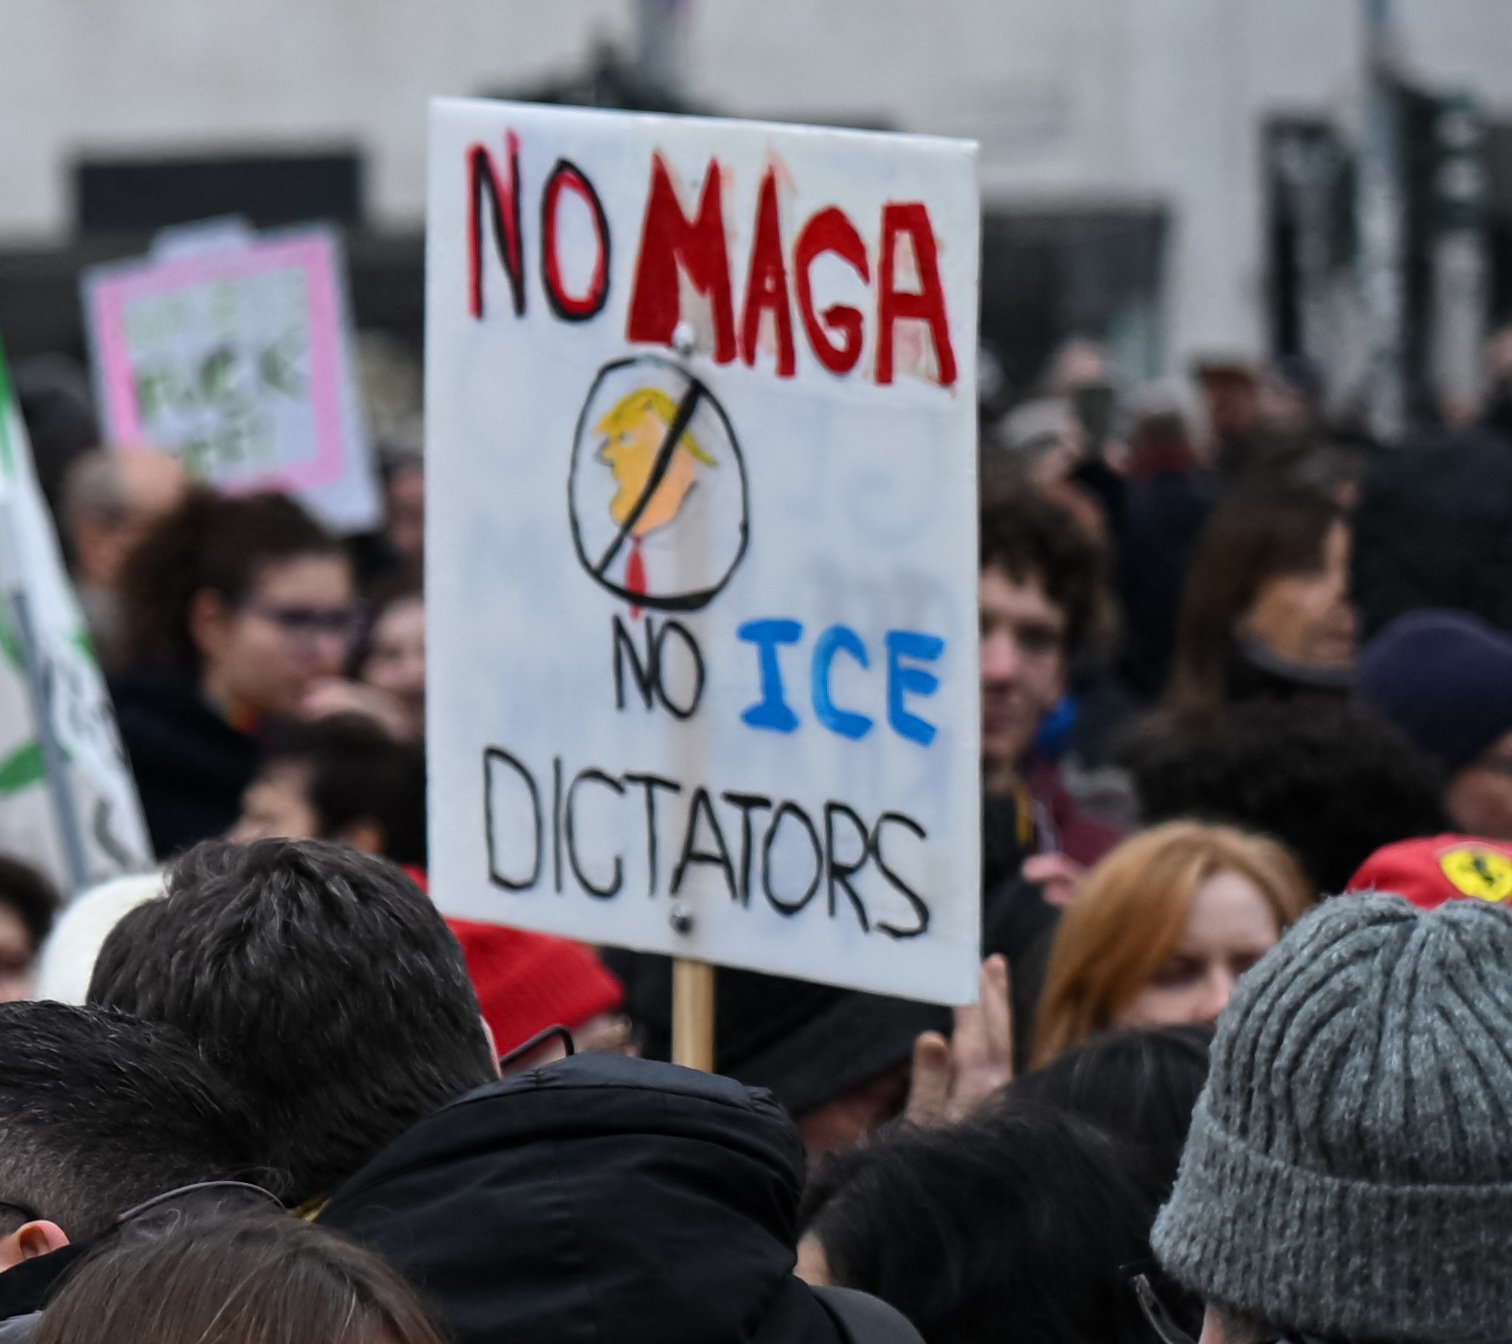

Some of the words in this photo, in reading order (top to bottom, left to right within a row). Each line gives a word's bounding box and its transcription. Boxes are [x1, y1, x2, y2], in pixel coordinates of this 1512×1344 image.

[467, 130, 612, 323] NO
[626, 148, 958, 388] MAGA
[612, 613, 708, 720] NO
[737, 617, 946, 748] ICE
[482, 745, 930, 941] DICTATORS
